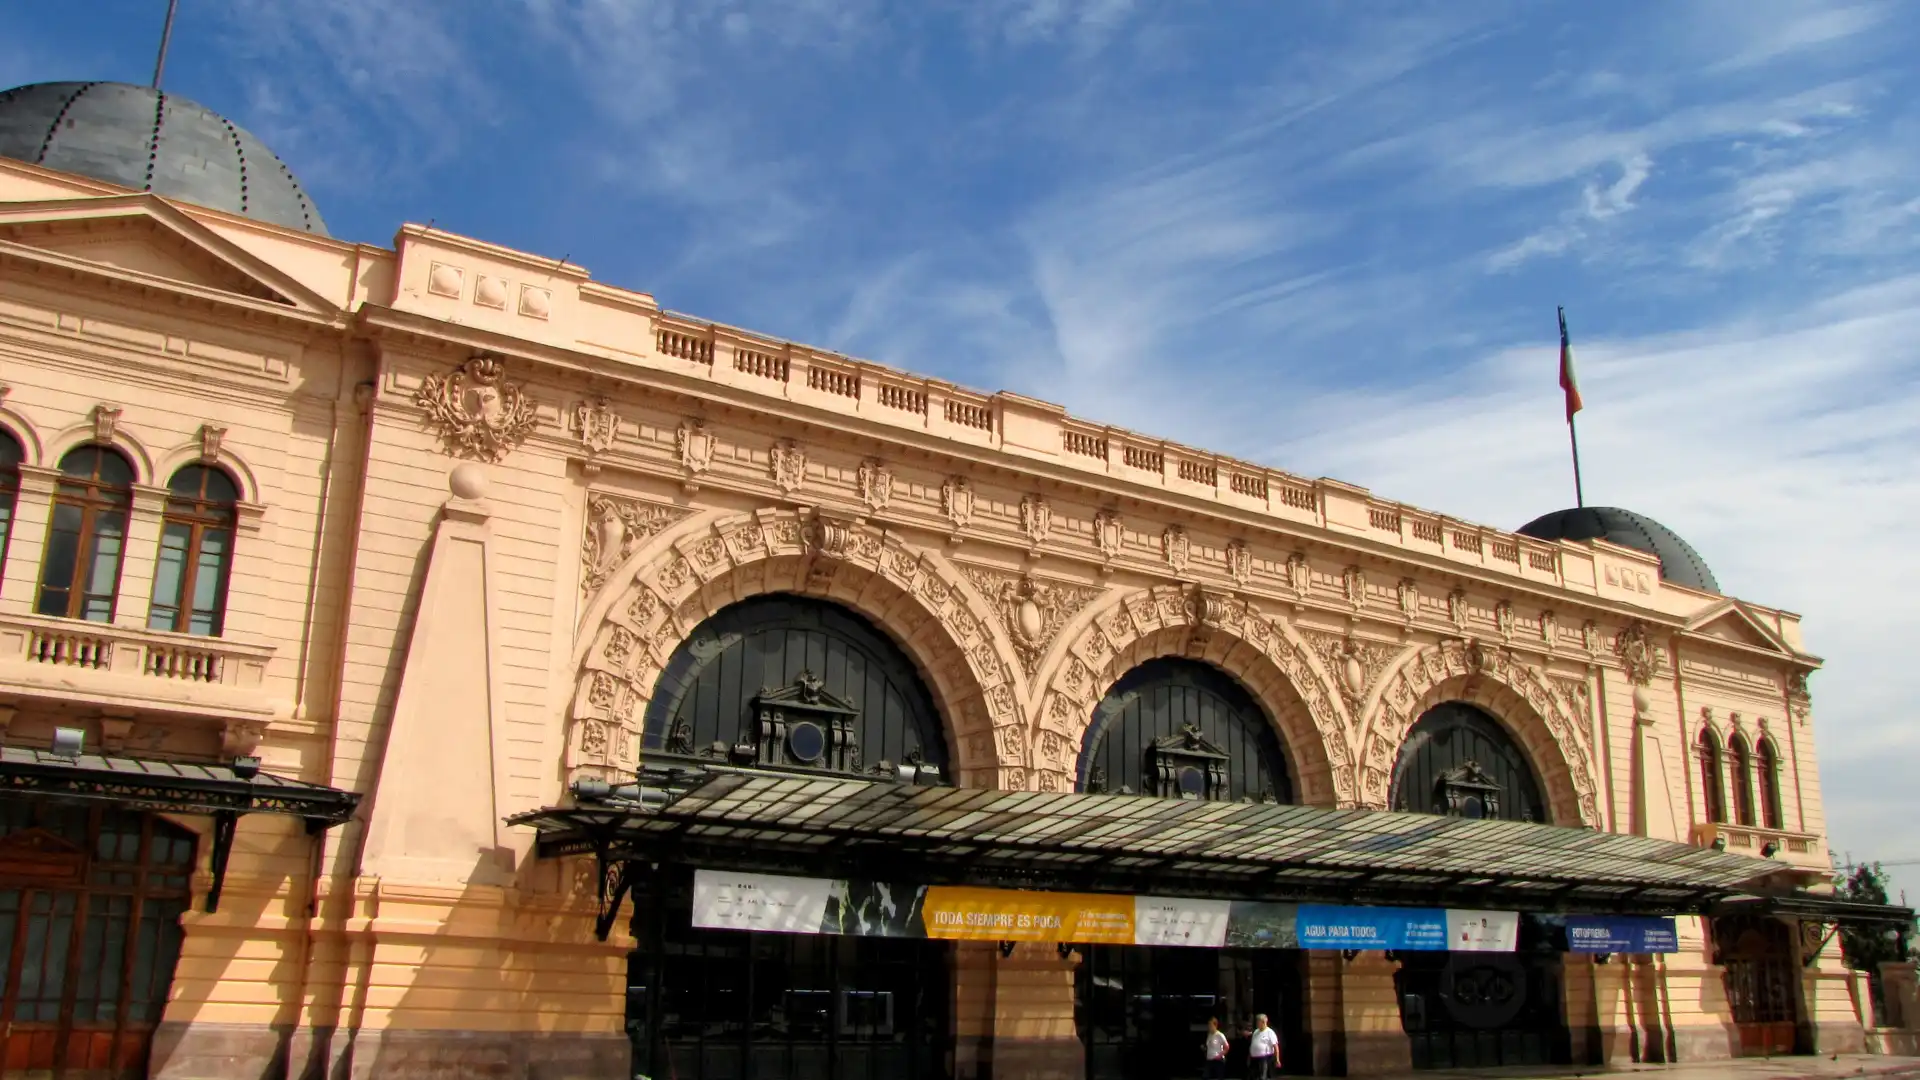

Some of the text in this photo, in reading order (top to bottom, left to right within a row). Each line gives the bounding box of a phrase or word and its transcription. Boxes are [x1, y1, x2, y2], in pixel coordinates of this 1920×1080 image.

[934, 911, 963, 925] TODA
[966, 912, 1013, 927] SIEMPRE
[1017, 914, 1031, 928] ES
[1033, 915, 1062, 929] POCA
[1304, 925, 1377, 938] AGUA PARA TODOS
